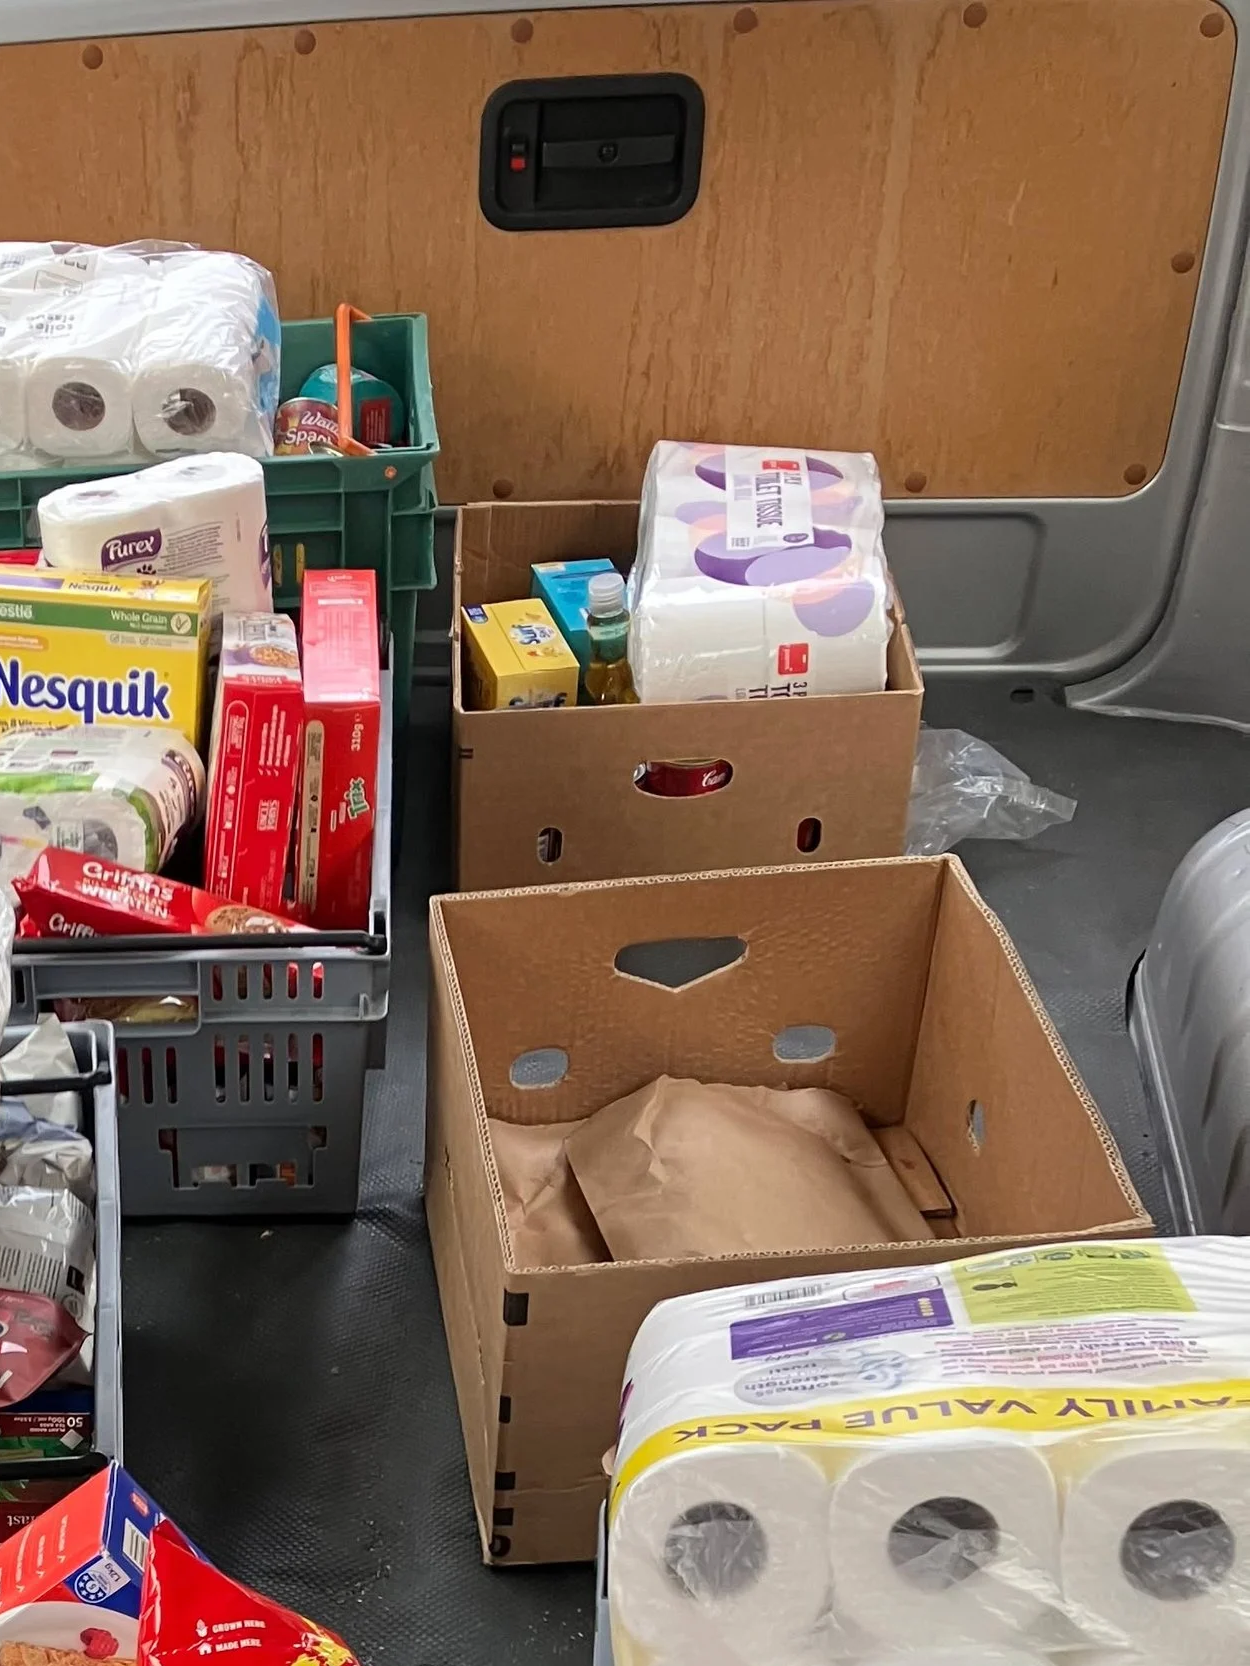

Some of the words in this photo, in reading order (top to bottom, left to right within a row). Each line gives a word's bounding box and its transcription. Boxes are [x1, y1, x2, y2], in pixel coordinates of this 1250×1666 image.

[755, 472, 782, 495] TOILET
[755, 496, 782, 528] TISSUE
[105, 535, 154, 561] Purex
[68, 582, 123, 593] Nesquik
[111, 610, 141, 623] Whole
[142, 612, 168, 624] Grain
[351, 723, 363, 751] 310g
[347, 778, 370, 820] Trix
[258, 800, 267, 830] UNCLE
[743, 1373, 832, 1391] strength
[755, 1380, 839, 1398] softness
[67, 1416, 83, 1428] 50
[845, 1396, 1039, 1429] VALUE
[673, 1417, 825, 1444] PACK
[212, 1621, 242, 1633] GROWN
[215, 1641, 239, 1652] MADE
